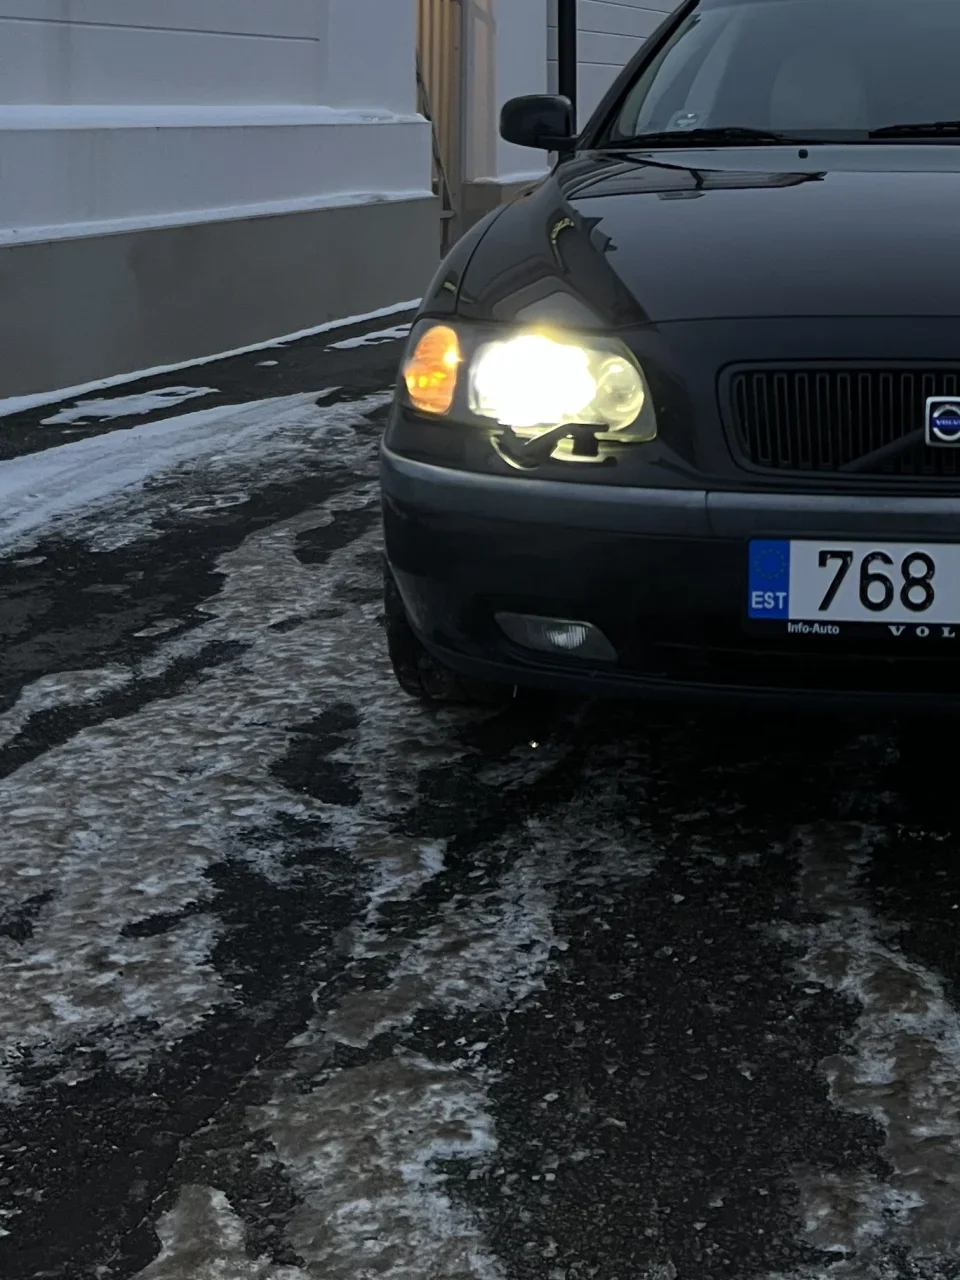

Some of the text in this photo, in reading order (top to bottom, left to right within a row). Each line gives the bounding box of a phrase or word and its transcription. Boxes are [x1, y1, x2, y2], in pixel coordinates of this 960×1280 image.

[818, 550, 936, 612] 768
[751, 591, 786, 609] EST
[787, 621, 840, 635] Info-Auto
